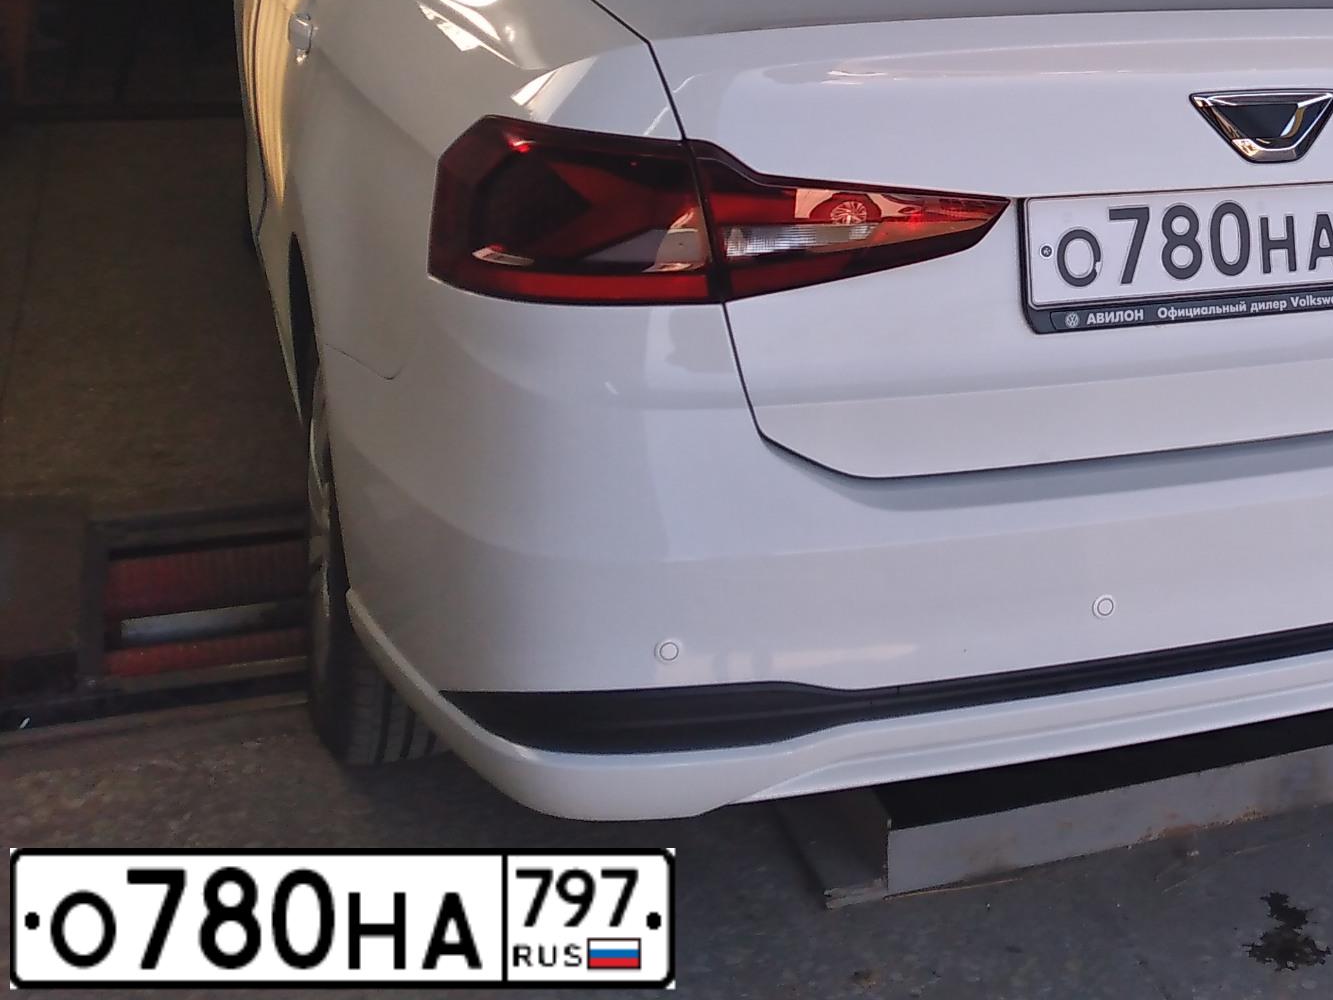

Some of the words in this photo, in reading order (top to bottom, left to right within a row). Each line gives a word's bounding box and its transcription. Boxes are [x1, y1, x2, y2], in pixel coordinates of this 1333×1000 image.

[1086, 309, 1144, 326] АВИЛОН
[1157, 300, 1247, 321] Официальный
[1250, 300, 1287, 313] дилер
